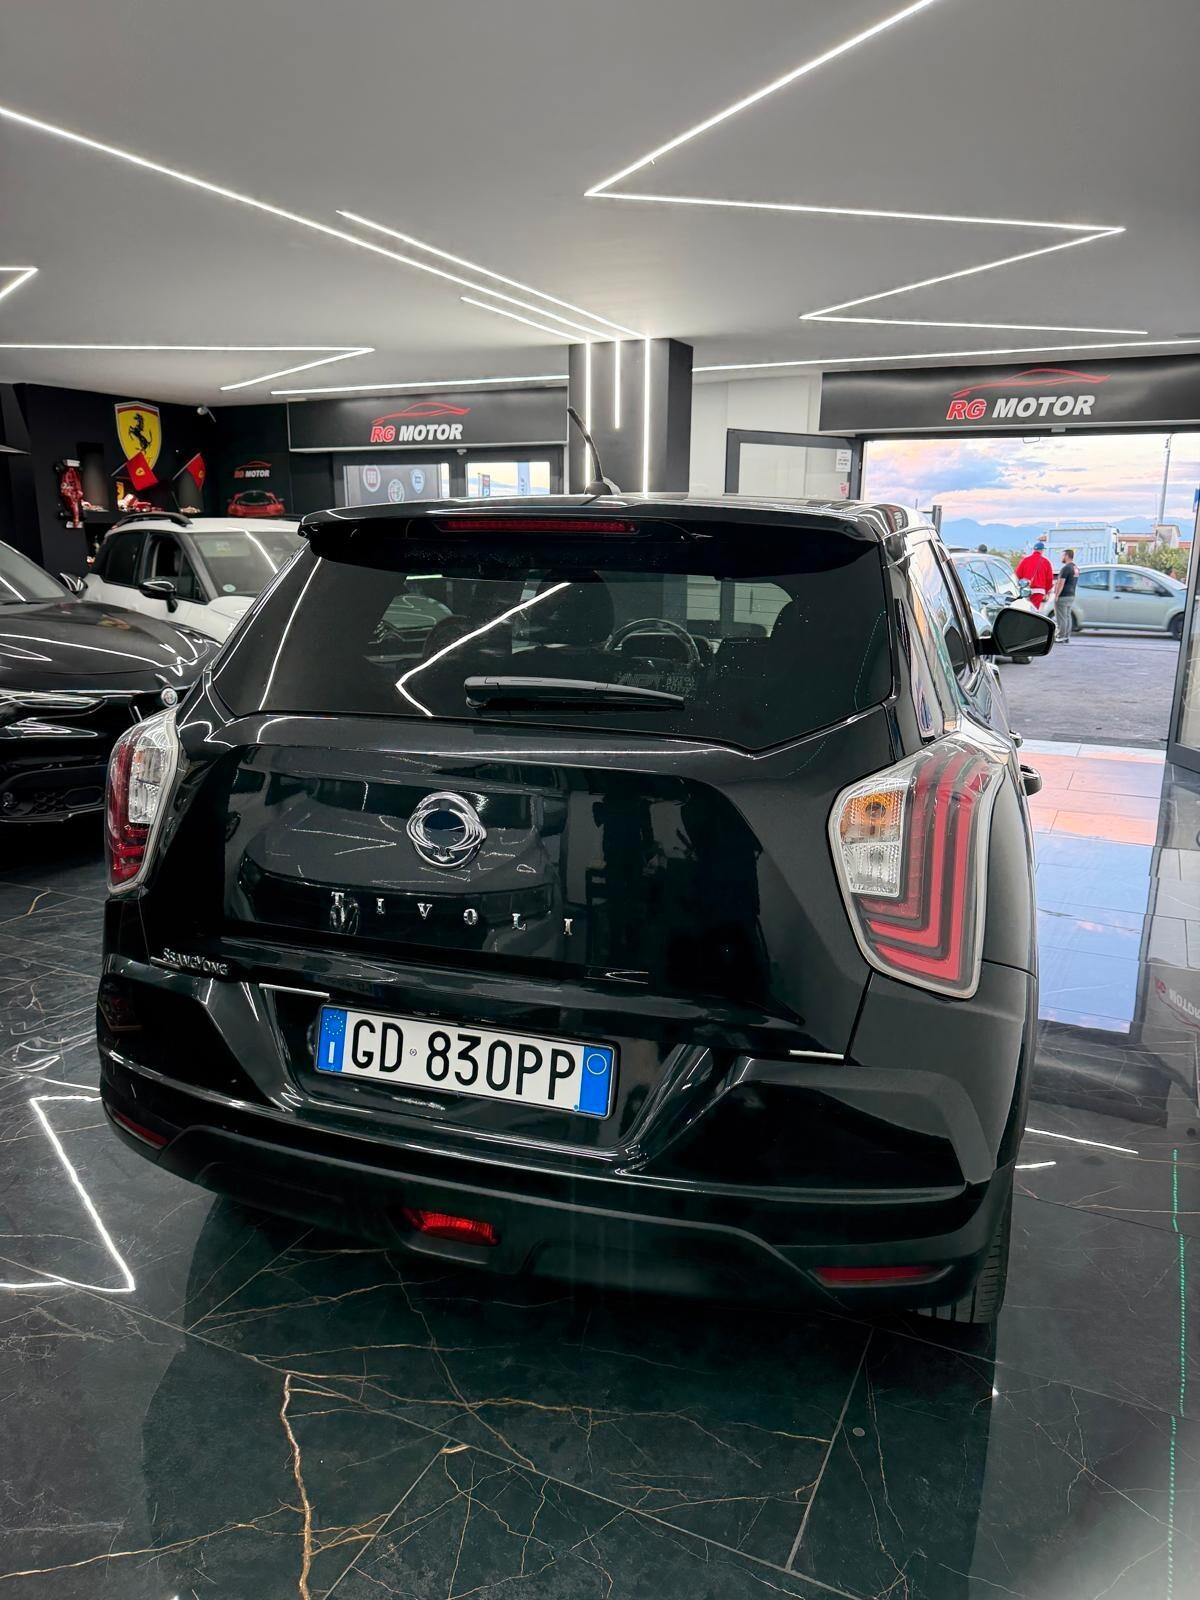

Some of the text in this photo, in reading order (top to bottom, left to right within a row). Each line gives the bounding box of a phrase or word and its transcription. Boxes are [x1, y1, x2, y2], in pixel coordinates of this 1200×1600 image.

[946, 395, 1096, 420] RG MOTOR
[370, 423, 463, 443] RG MOTOR
[331, 891, 573, 936] TIVOLI
[351, 1019, 576, 1100] GD 830PP
